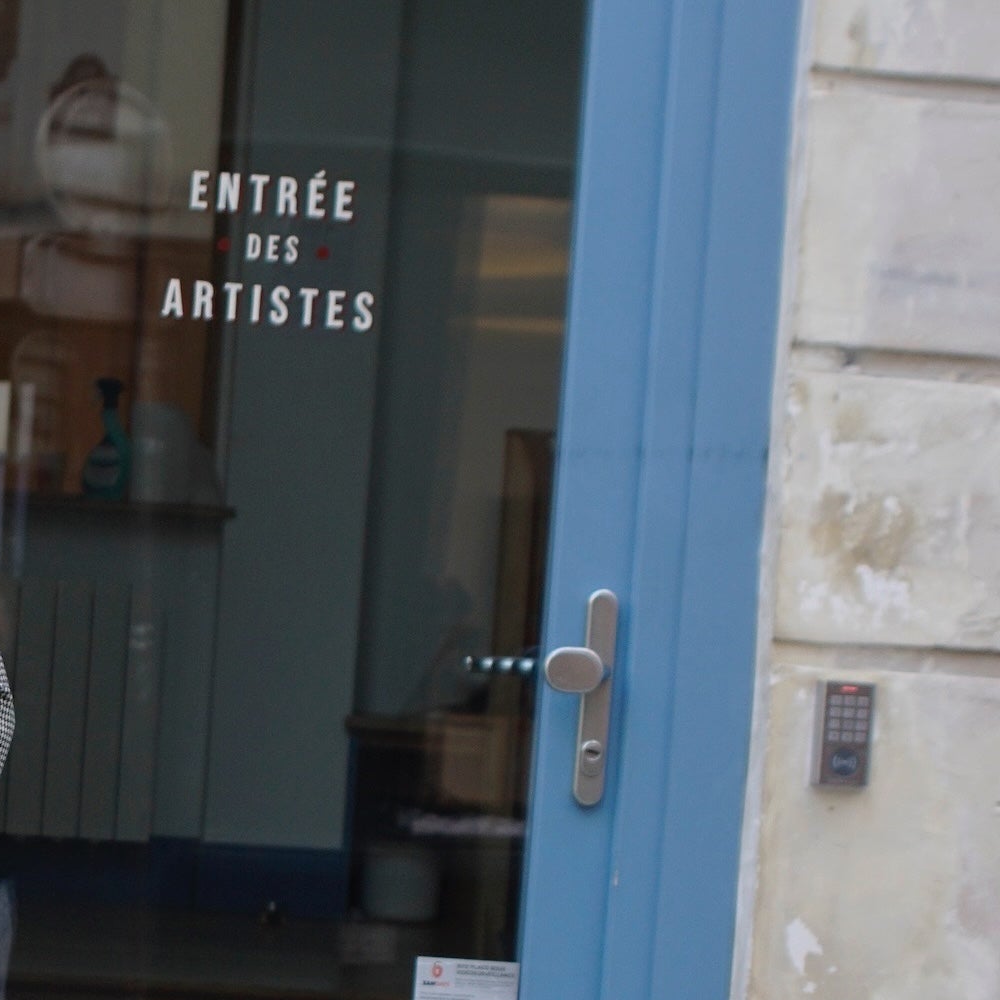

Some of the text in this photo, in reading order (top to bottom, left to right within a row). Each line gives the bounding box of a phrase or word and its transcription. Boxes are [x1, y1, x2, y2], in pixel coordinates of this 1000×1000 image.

[188, 169, 355, 221] ENTRÉE
[246, 232, 299, 264] DES
[161, 278, 374, 331] ARTISTES
